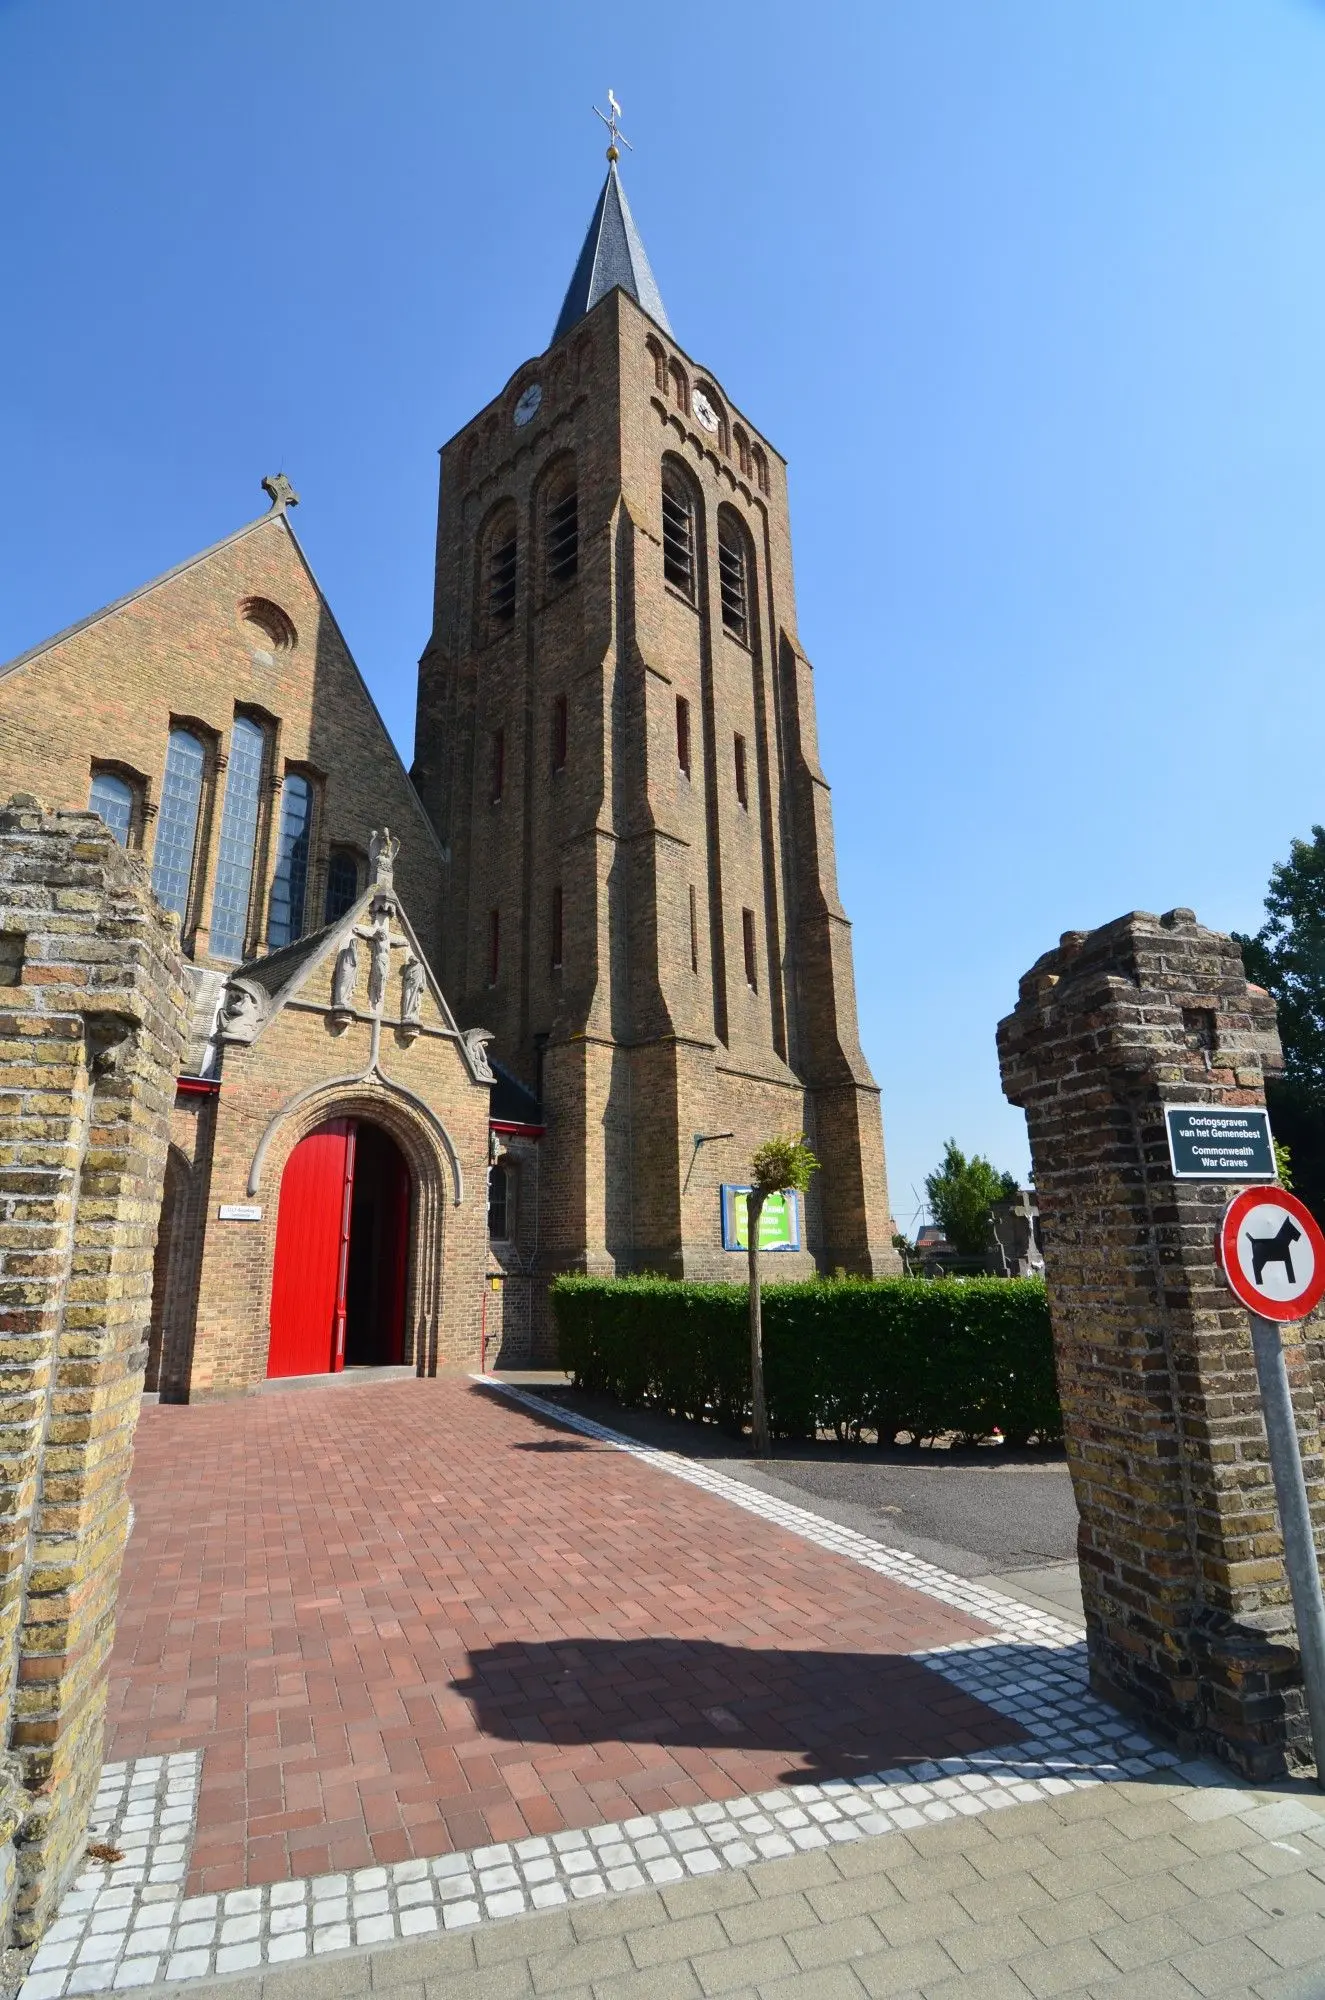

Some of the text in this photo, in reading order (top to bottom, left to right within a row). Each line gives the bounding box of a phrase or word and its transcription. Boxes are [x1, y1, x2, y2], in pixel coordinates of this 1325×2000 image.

[1189, 1117, 1248, 1128] Oorlogsgraven
[1196, 1128, 1210, 1138] het
[1211, 1129, 1260, 1138] Gemenebest
[1192, 1146, 1254, 1155] Commonwealth
[1201, 1157, 1248, 1167] War Graves
